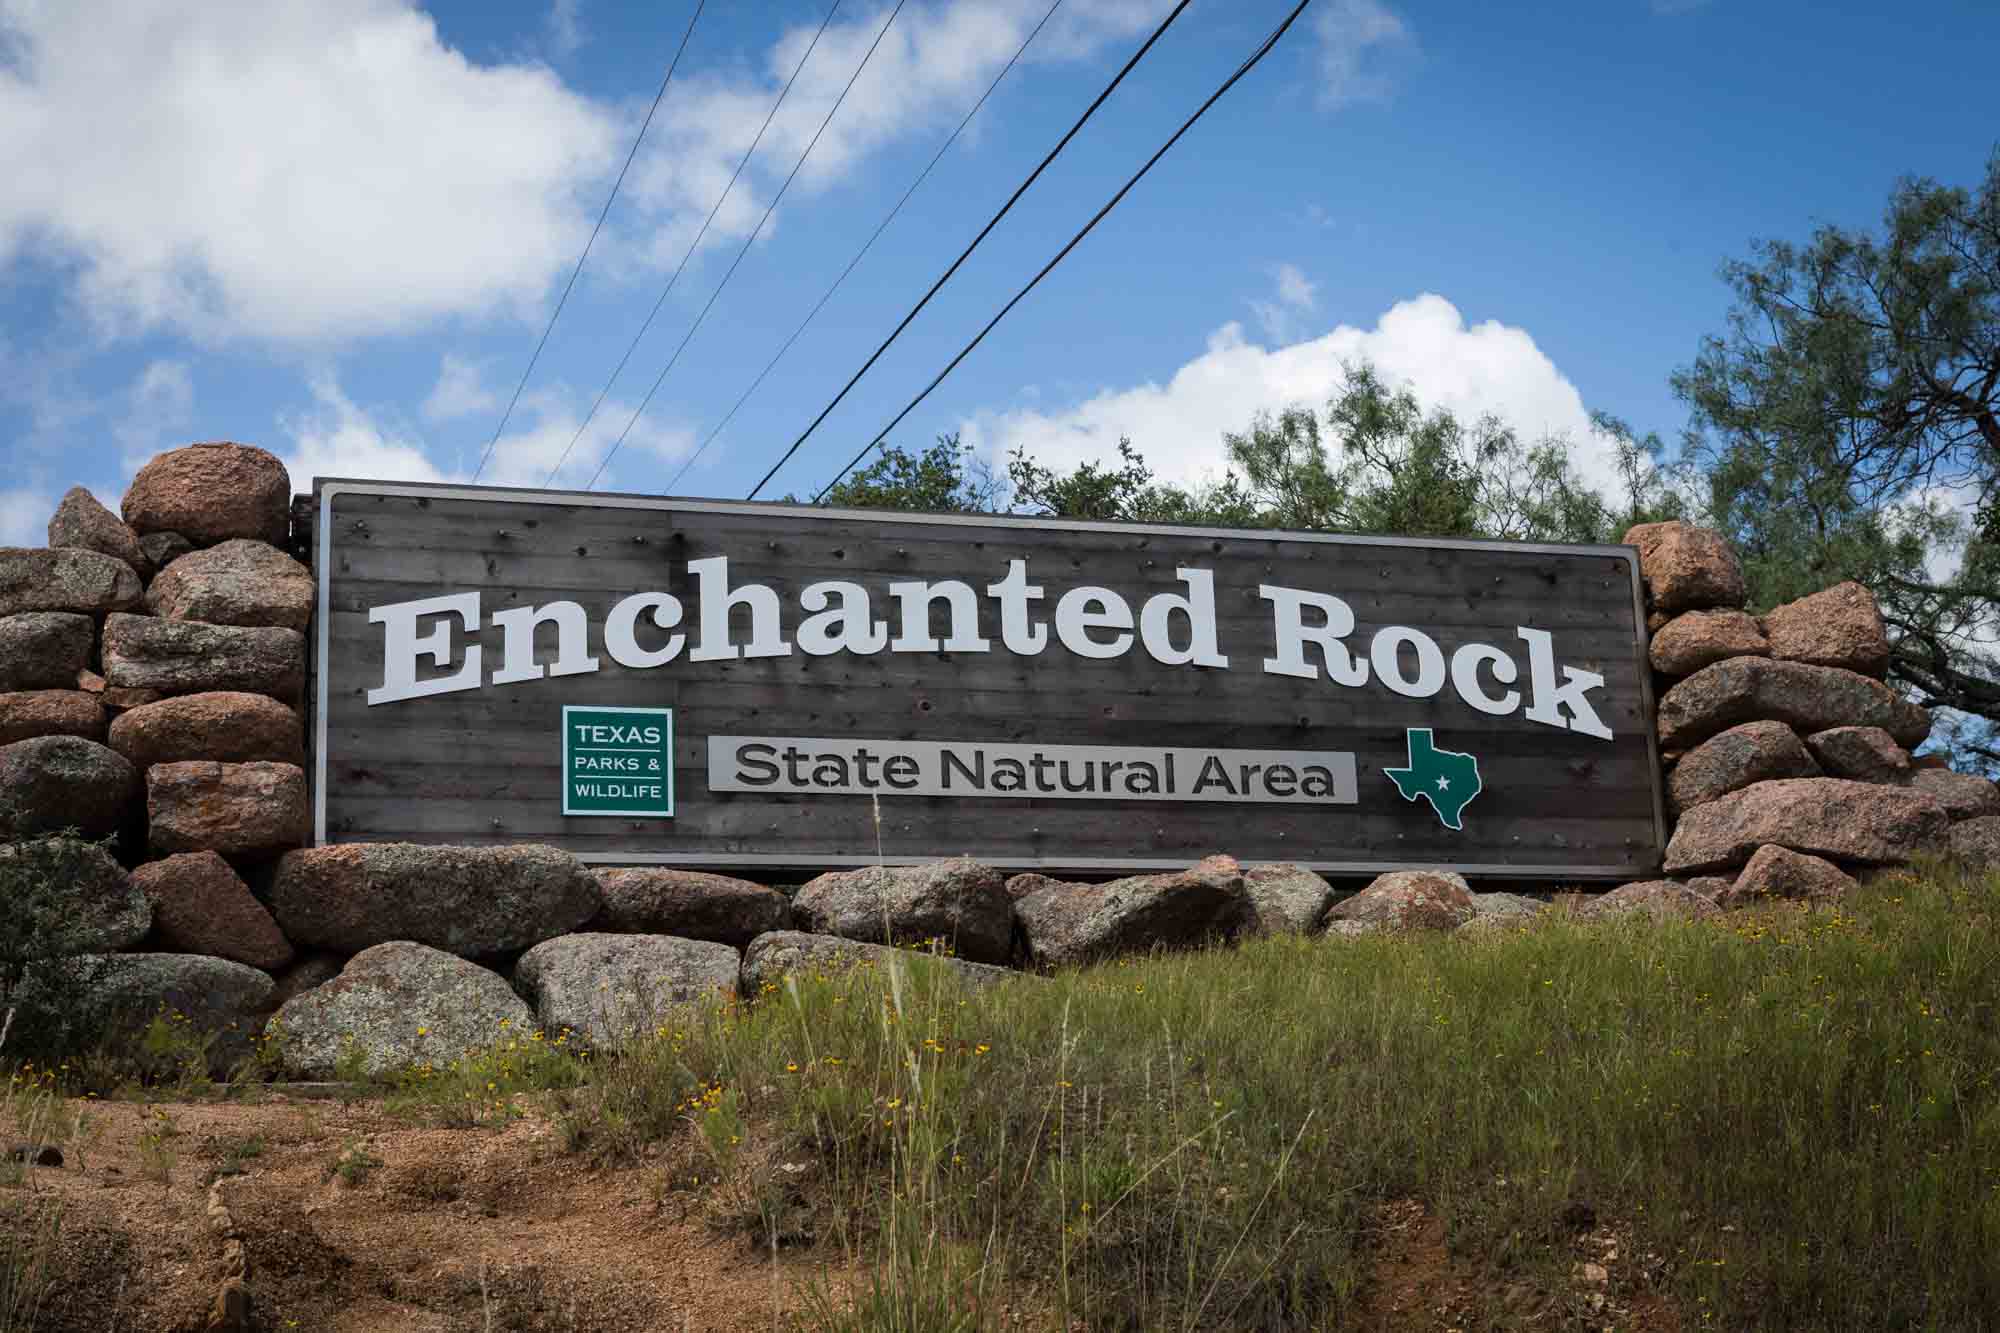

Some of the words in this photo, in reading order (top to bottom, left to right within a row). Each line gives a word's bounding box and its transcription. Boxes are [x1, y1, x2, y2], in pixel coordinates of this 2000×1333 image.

[368, 556, 1230, 706] Enchanted
[1259, 584, 1614, 741] Rock
[575, 725, 661, 744] TEXAS
[575, 757, 640, 770] PARKS
[648, 758, 660, 770] &
[735, 743, 920, 789] State
[940, 749, 1175, 794] Natural
[1192, 756, 1335, 798] Area
[575, 784, 662, 798] WILDLIFE
